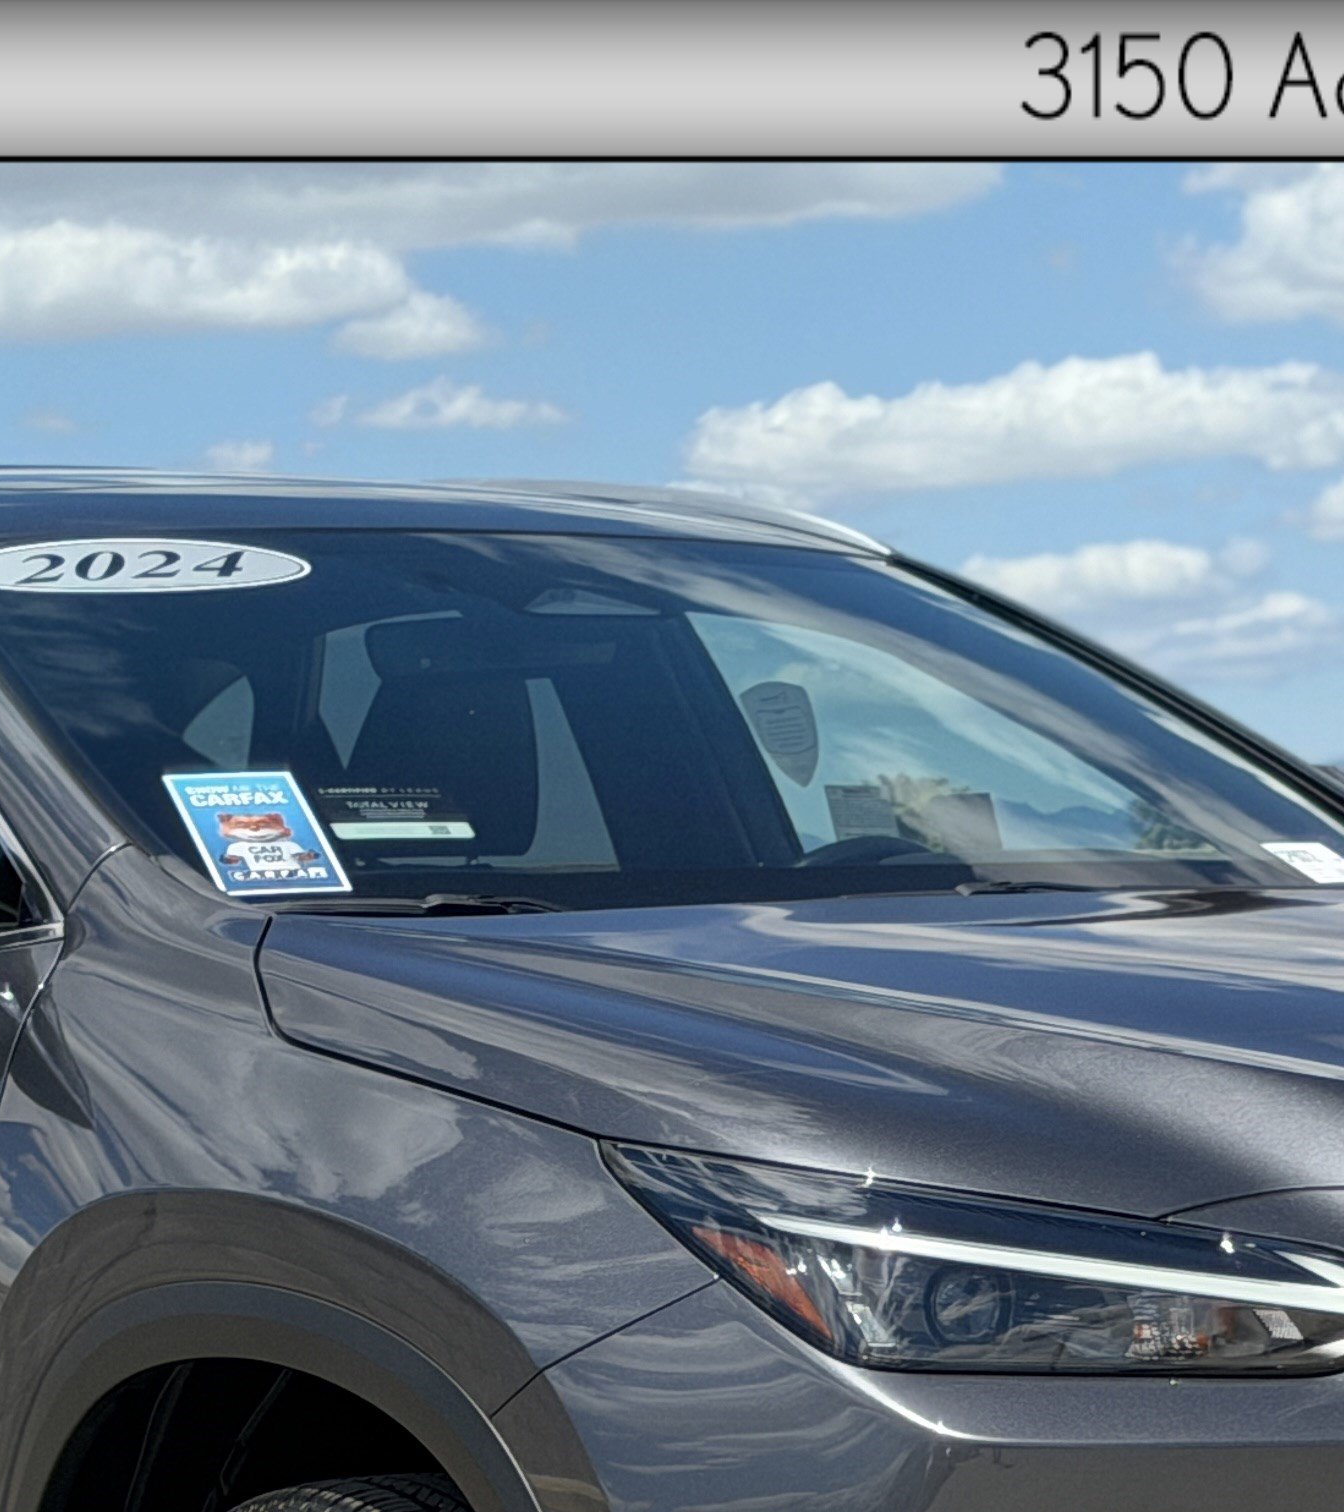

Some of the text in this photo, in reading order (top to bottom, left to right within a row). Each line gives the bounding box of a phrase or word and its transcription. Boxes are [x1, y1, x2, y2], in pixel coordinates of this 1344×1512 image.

[15, 549, 247, 585] 2024
[189, 791, 288, 807] CARFAX
[248, 845, 283, 854] CAR
[253, 854, 286, 864] FOX
